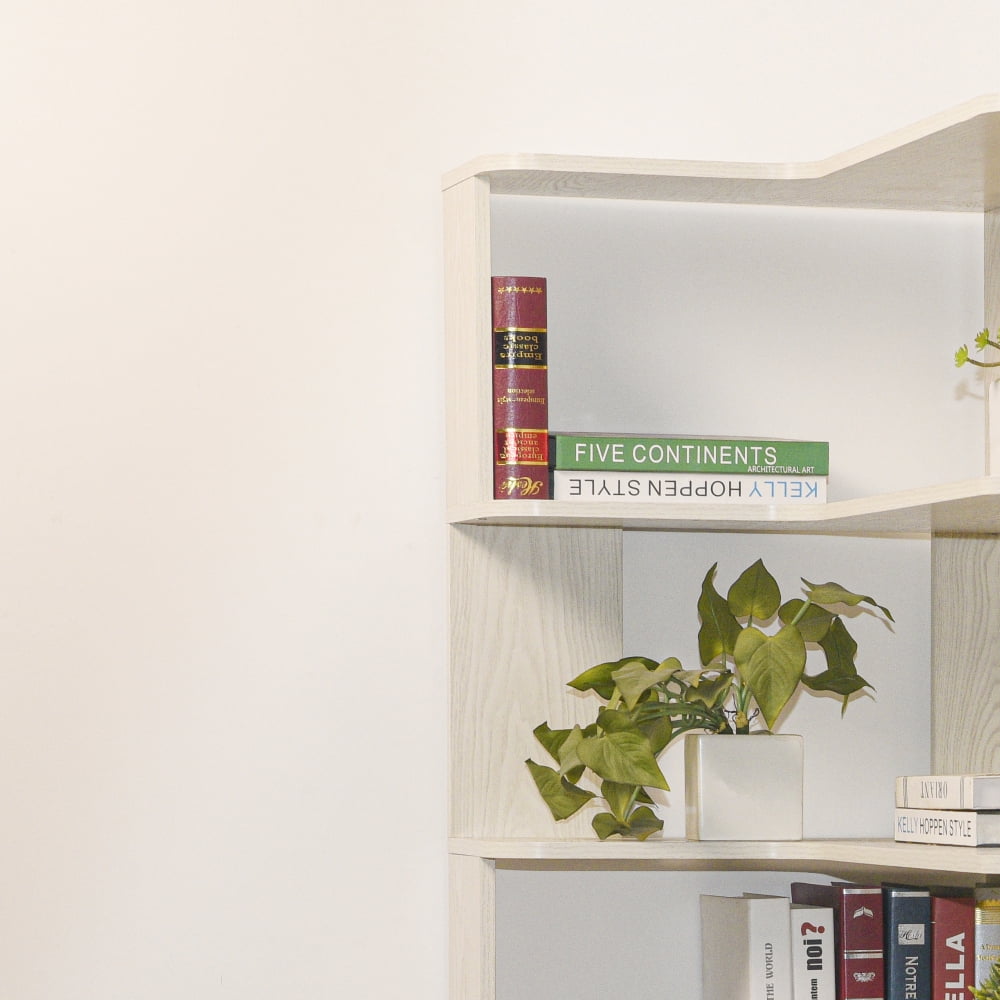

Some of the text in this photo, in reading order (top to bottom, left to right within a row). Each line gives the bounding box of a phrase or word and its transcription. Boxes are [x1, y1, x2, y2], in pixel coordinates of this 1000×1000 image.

[502, 343, 539, 352] classic
[503, 335, 538, 343] books
[500, 351, 542, 360] Empire
[575, 443, 778, 466] FIVE CONTINENTS
[747, 465, 815, 474] ARCHITECTURAL ART
[569, 479, 818, 498] KELLY HOPPEN STYLE
[898, 816, 972, 838] KELLY HOPPEN STYLE
[801, 922, 826, 971] noi?
[765, 942, 774, 980] WORLD
[905, 956, 919, 1000] NOTRE
